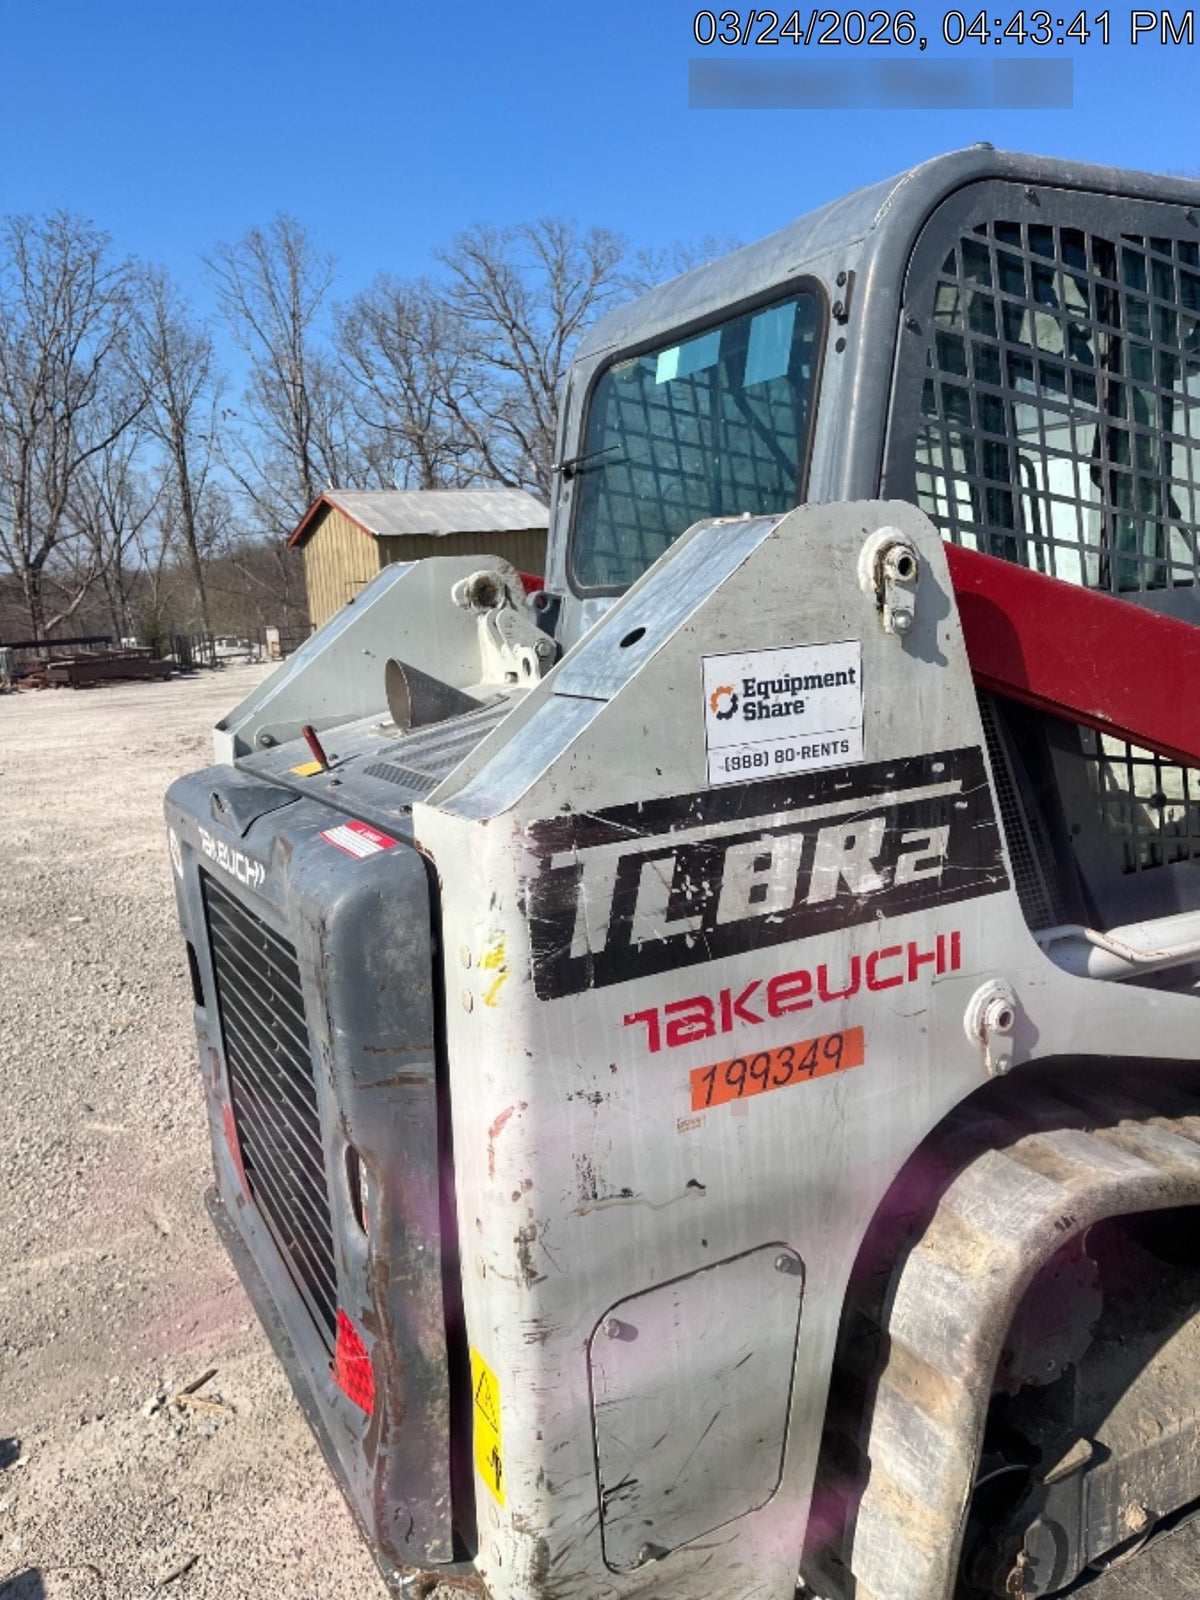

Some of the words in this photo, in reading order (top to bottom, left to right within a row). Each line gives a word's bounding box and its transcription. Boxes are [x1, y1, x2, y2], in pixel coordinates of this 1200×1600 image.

[742, 667, 856, 699] Equipment
[743, 700, 805, 721] Share
[774, 740, 849, 764] 80-RENTS
[701, 1033, 844, 1105] 199349
